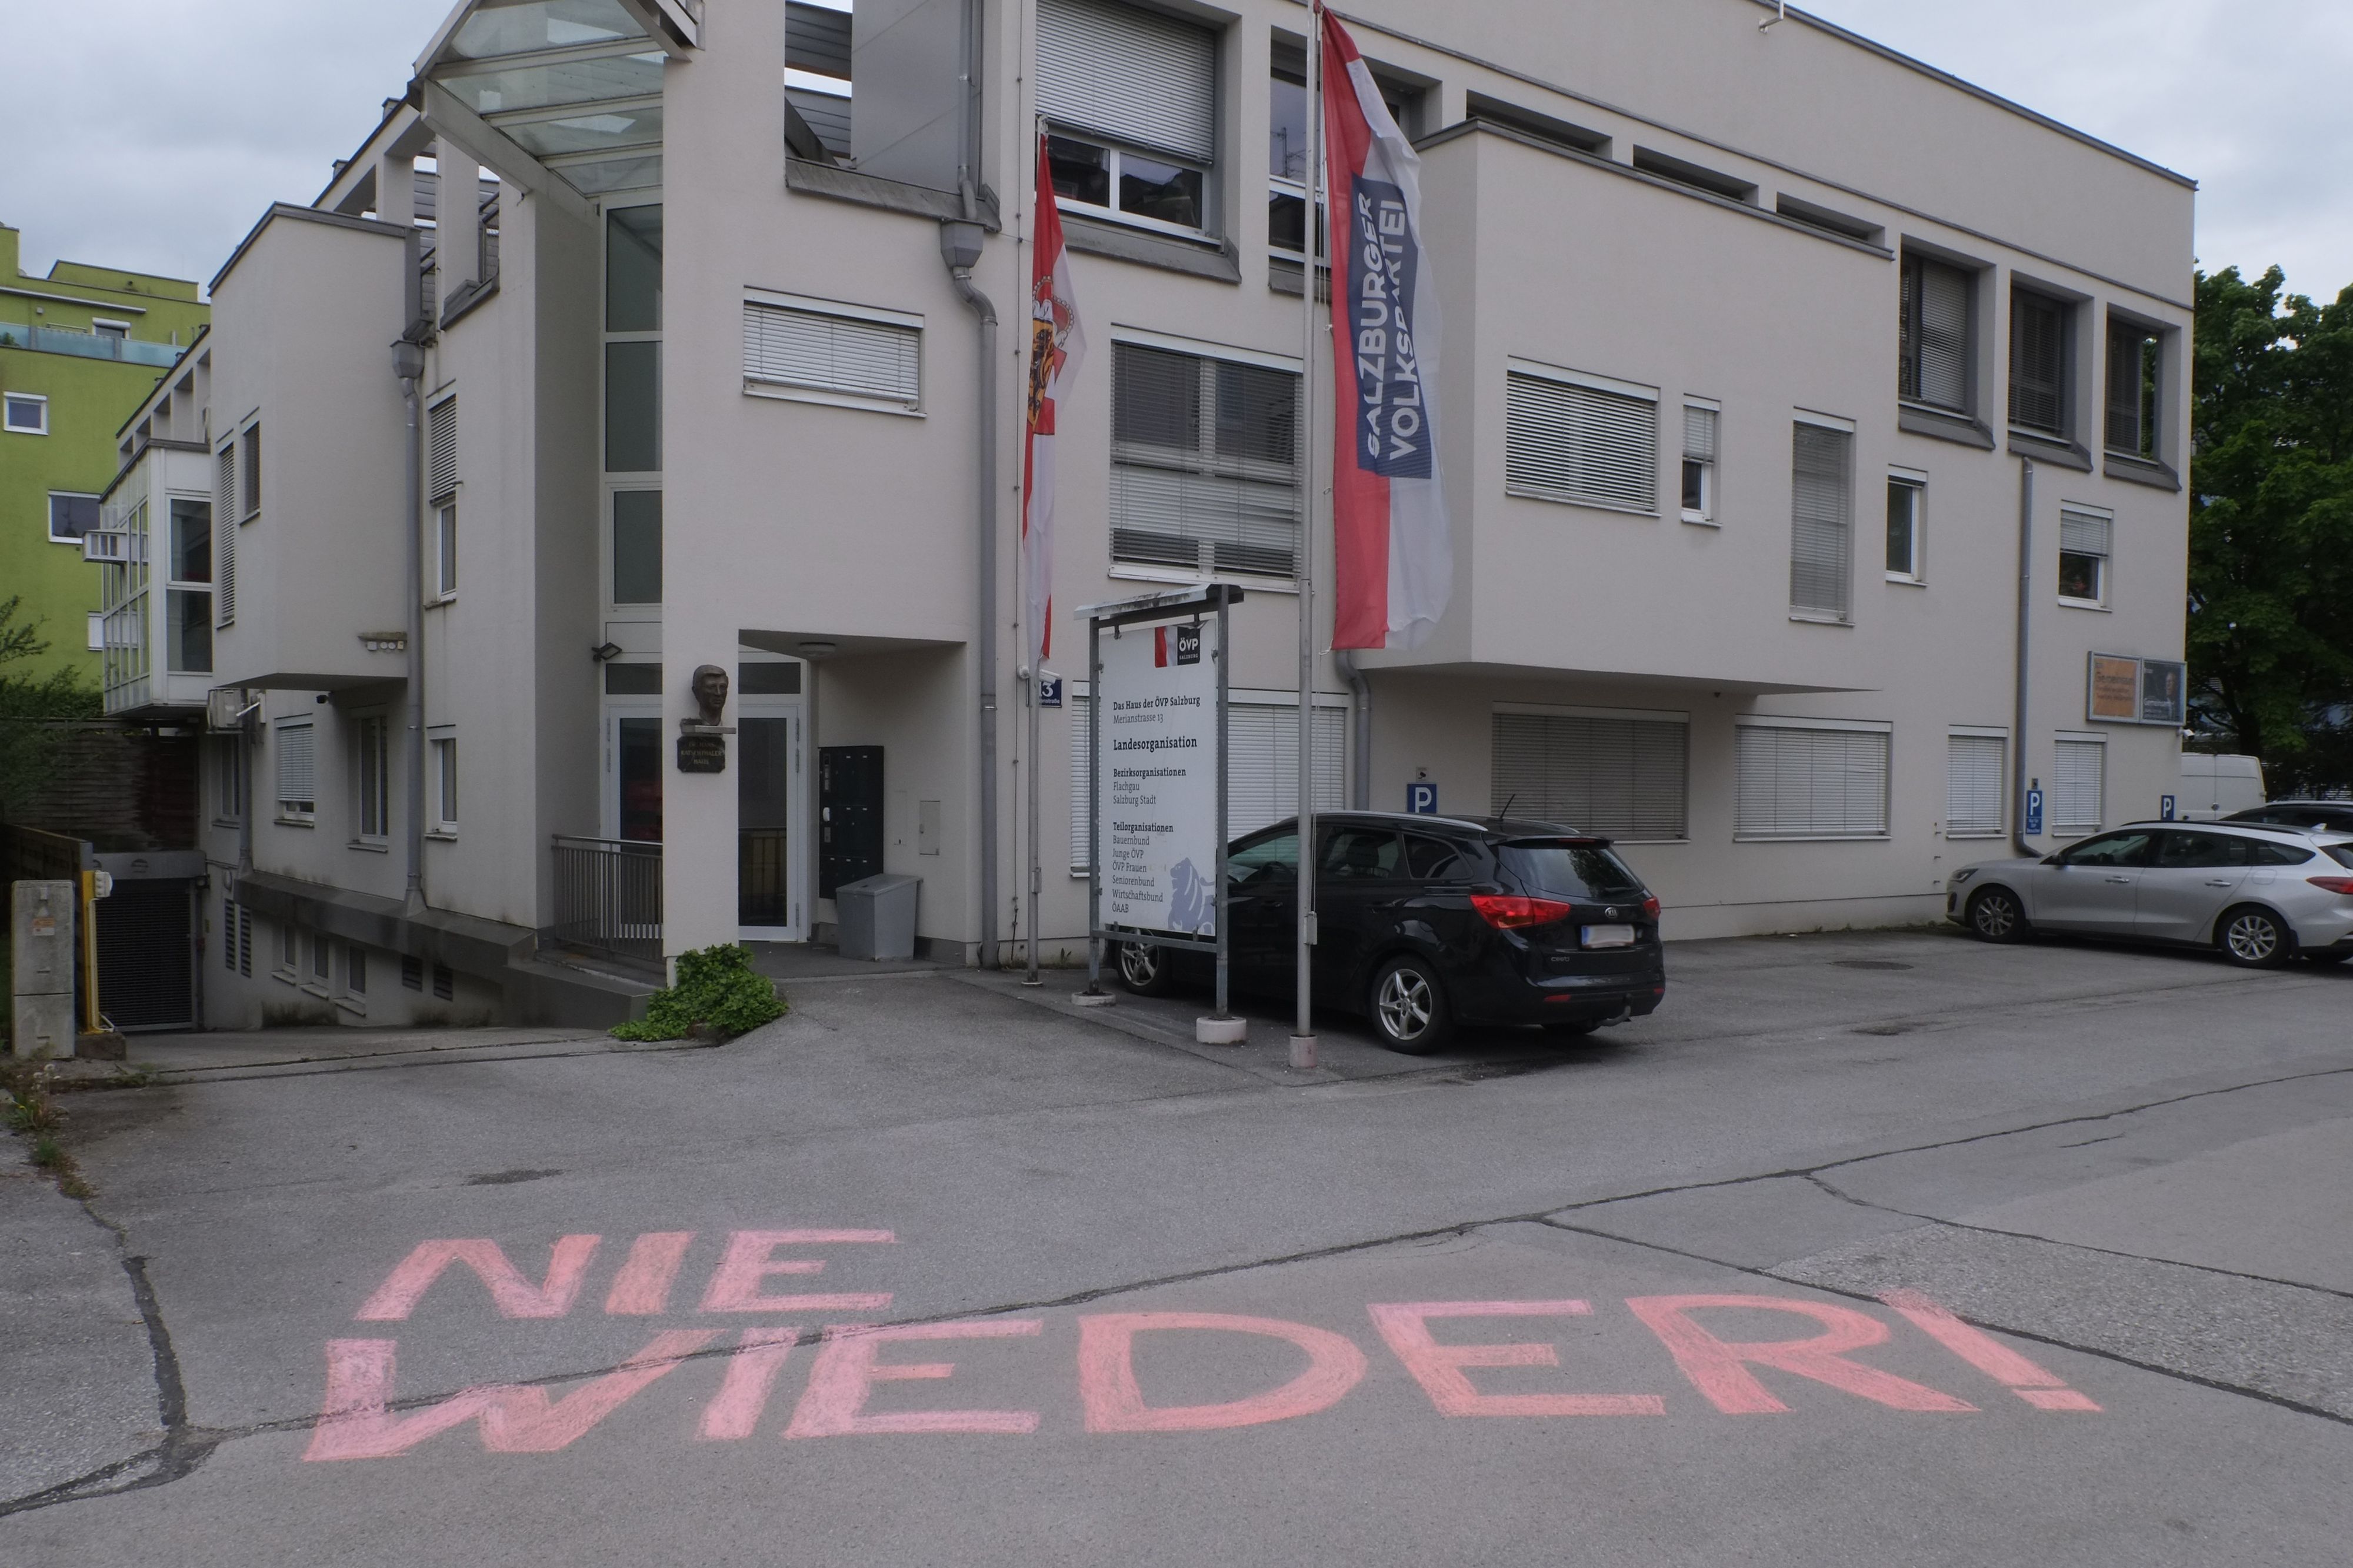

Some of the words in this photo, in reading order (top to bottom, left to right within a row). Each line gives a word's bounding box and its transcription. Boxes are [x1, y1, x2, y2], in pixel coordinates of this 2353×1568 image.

[1358, 192, 1388, 459] SALZBURGER
[1179, 638, 1199, 652] ÖVP
[1042, 681, 1054, 698] 3
[1113, 702, 1125, 710] Das
[1125, 700, 1142, 710] Haus
[1143, 699, 1154, 708] der
[1155, 696, 1169, 707] ÖVP
[1170, 695, 1201, 708] Salzburg
[1113, 713, 1156, 724] Merianstrasse
[1157, 713, 1164, 723] 13
[1113, 736, 1198, 753] Landesorganisation
[1113, 767, 1187, 780] Bezirksorganisationen
[1113, 781, 1140, 794] Flachgau
[1113, 795, 1139, 808] Salzburg
[1139, 795, 1156, 805] Stadt
[1415, 786, 1432, 813] P
[2029, 792, 2040, 816] P
[2163, 798, 2172, 818] P
[1113, 822, 1174, 834] Teilorganisationen
[1113, 835, 1150, 846] Bauernbund
[1112, 848, 1130, 860] Junge
[1131, 848, 1144, 859] ÖVP
[1112, 860, 1125, 872] ÖVP
[1126, 862, 1147, 873] Frauen
[1112, 875, 1155, 887] Seniorenbund
[1112, 889, 1164, 903] Wirtschaftsbund
[1112, 902, 1129, 913] ÖAAB
[354, 1229, 898, 1321] NIE
[300, 1289, 2105, 1463] WIEDER!
